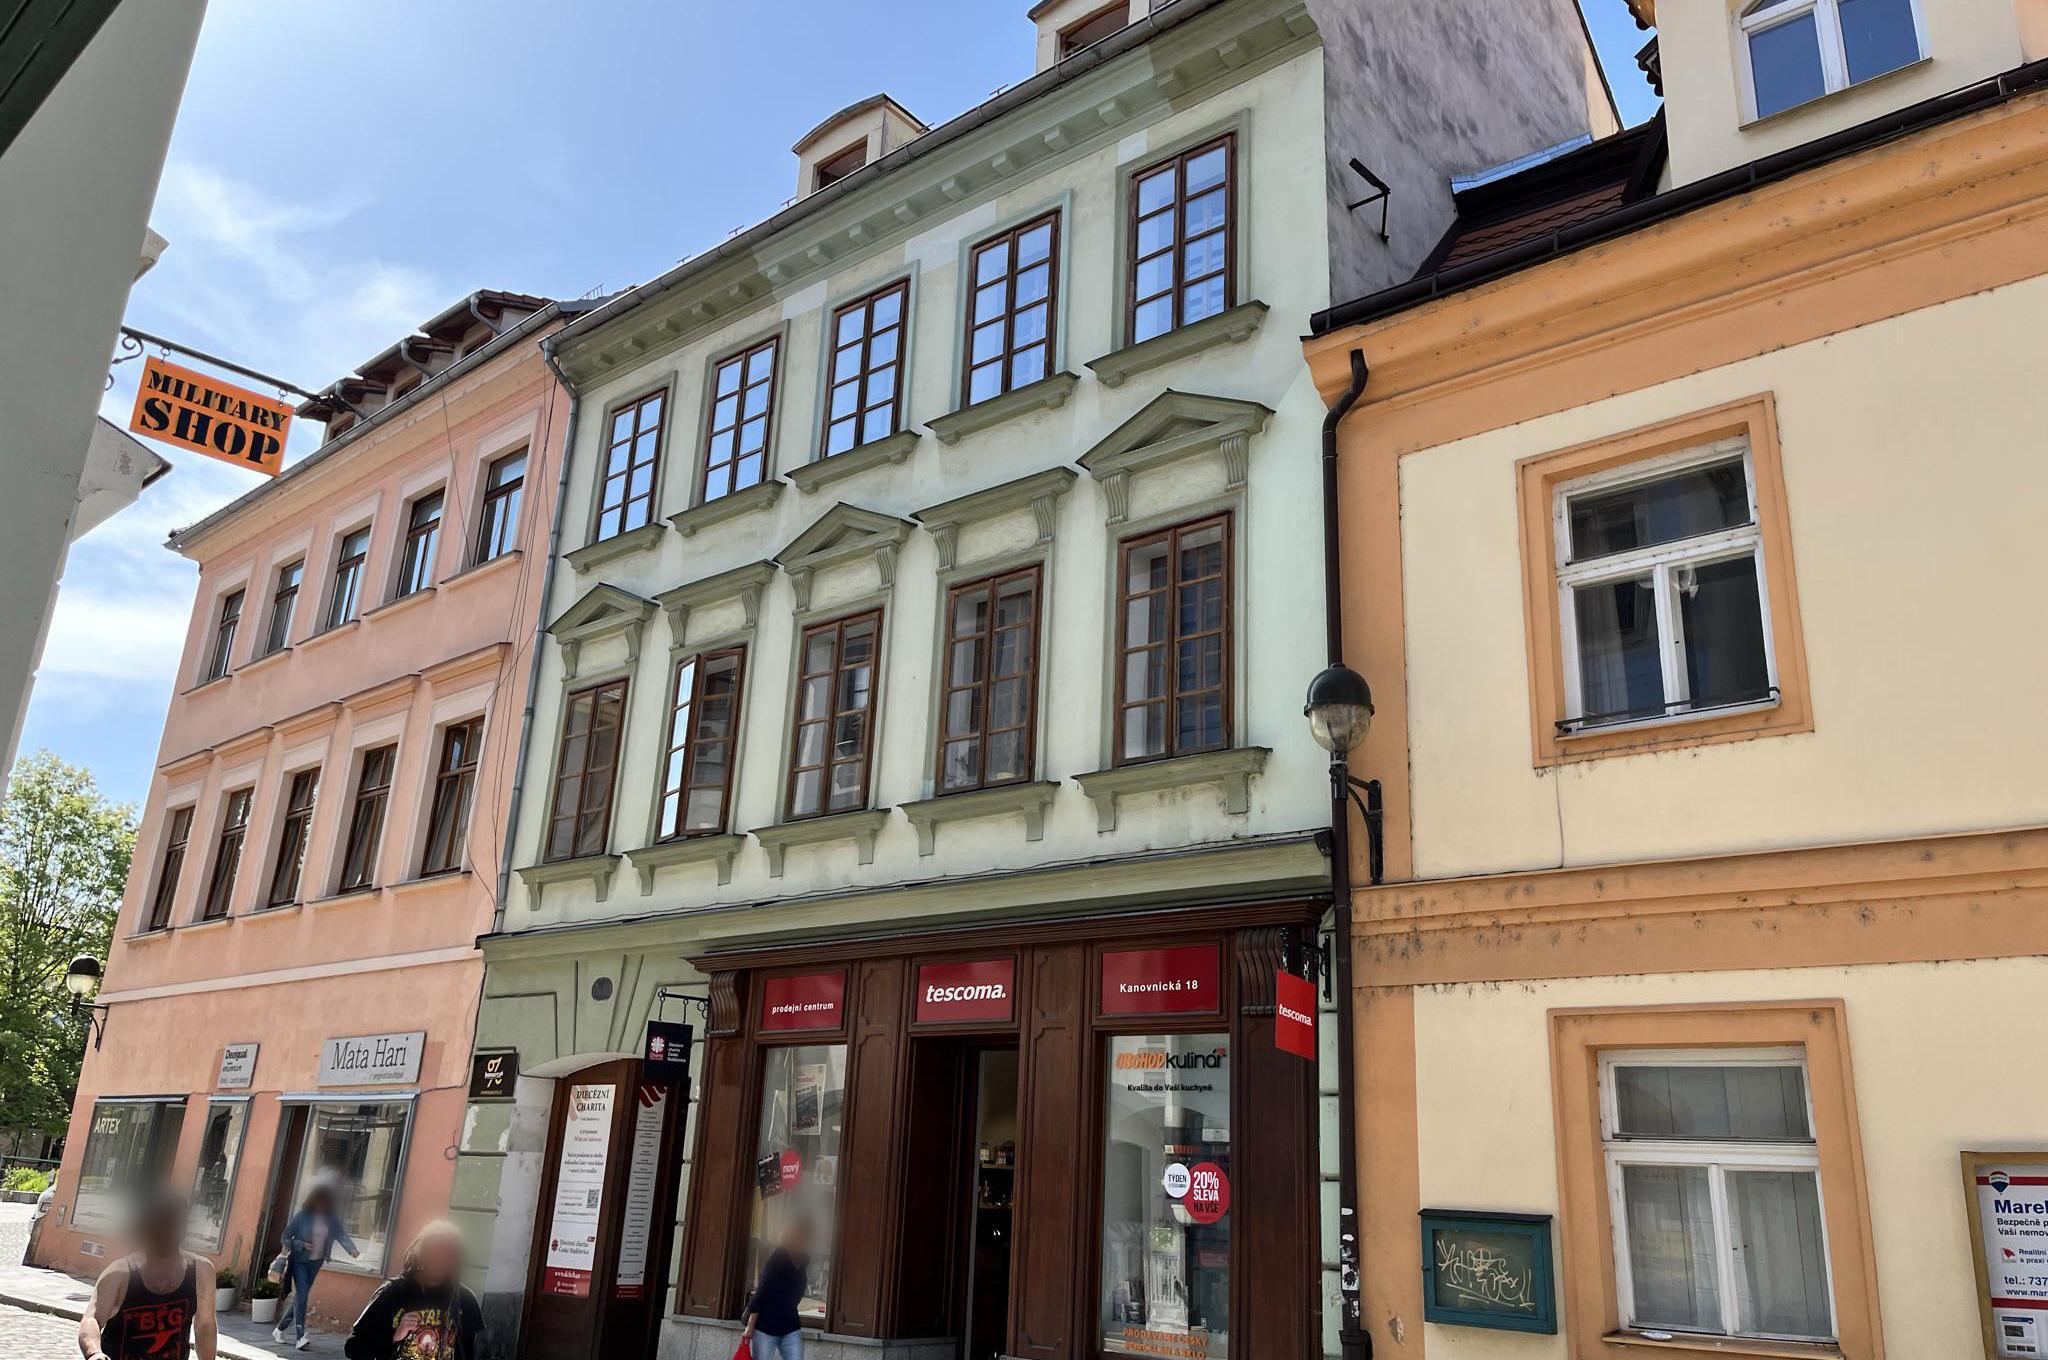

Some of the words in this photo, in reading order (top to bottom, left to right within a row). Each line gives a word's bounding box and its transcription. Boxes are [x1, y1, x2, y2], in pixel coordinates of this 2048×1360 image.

[147, 369, 287, 432] MILITARY
[140, 397, 280, 464] SHOP
[1120, 980, 1181, 993] Kanovnická
[1186, 980, 1198, 990] 18
[803, 1003, 834, 1012] centrum
[331, 1041, 370, 1070] Mata
[372, 1036, 409, 1068] Hari
[1128, 1084, 1153, 1092] Kvalita
[1154, 1084, 1164, 1092] do
[576, 1102, 607, 1112] CHARITA
[94, 1117, 122, 1134] ARTEX
[1193, 1171, 1220, 1189] 20%
[1193, 1188, 1219, 1201] SLEVA
[1194, 1202, 1204, 1213] NA
[1205, 1201, 1218, 1213] VŠE
[1994, 1199, 2048, 1214] Mare
[1997, 1217, 2041, 1227] Bezpečně
[2004, 1276, 2026, 1285] tel.:
